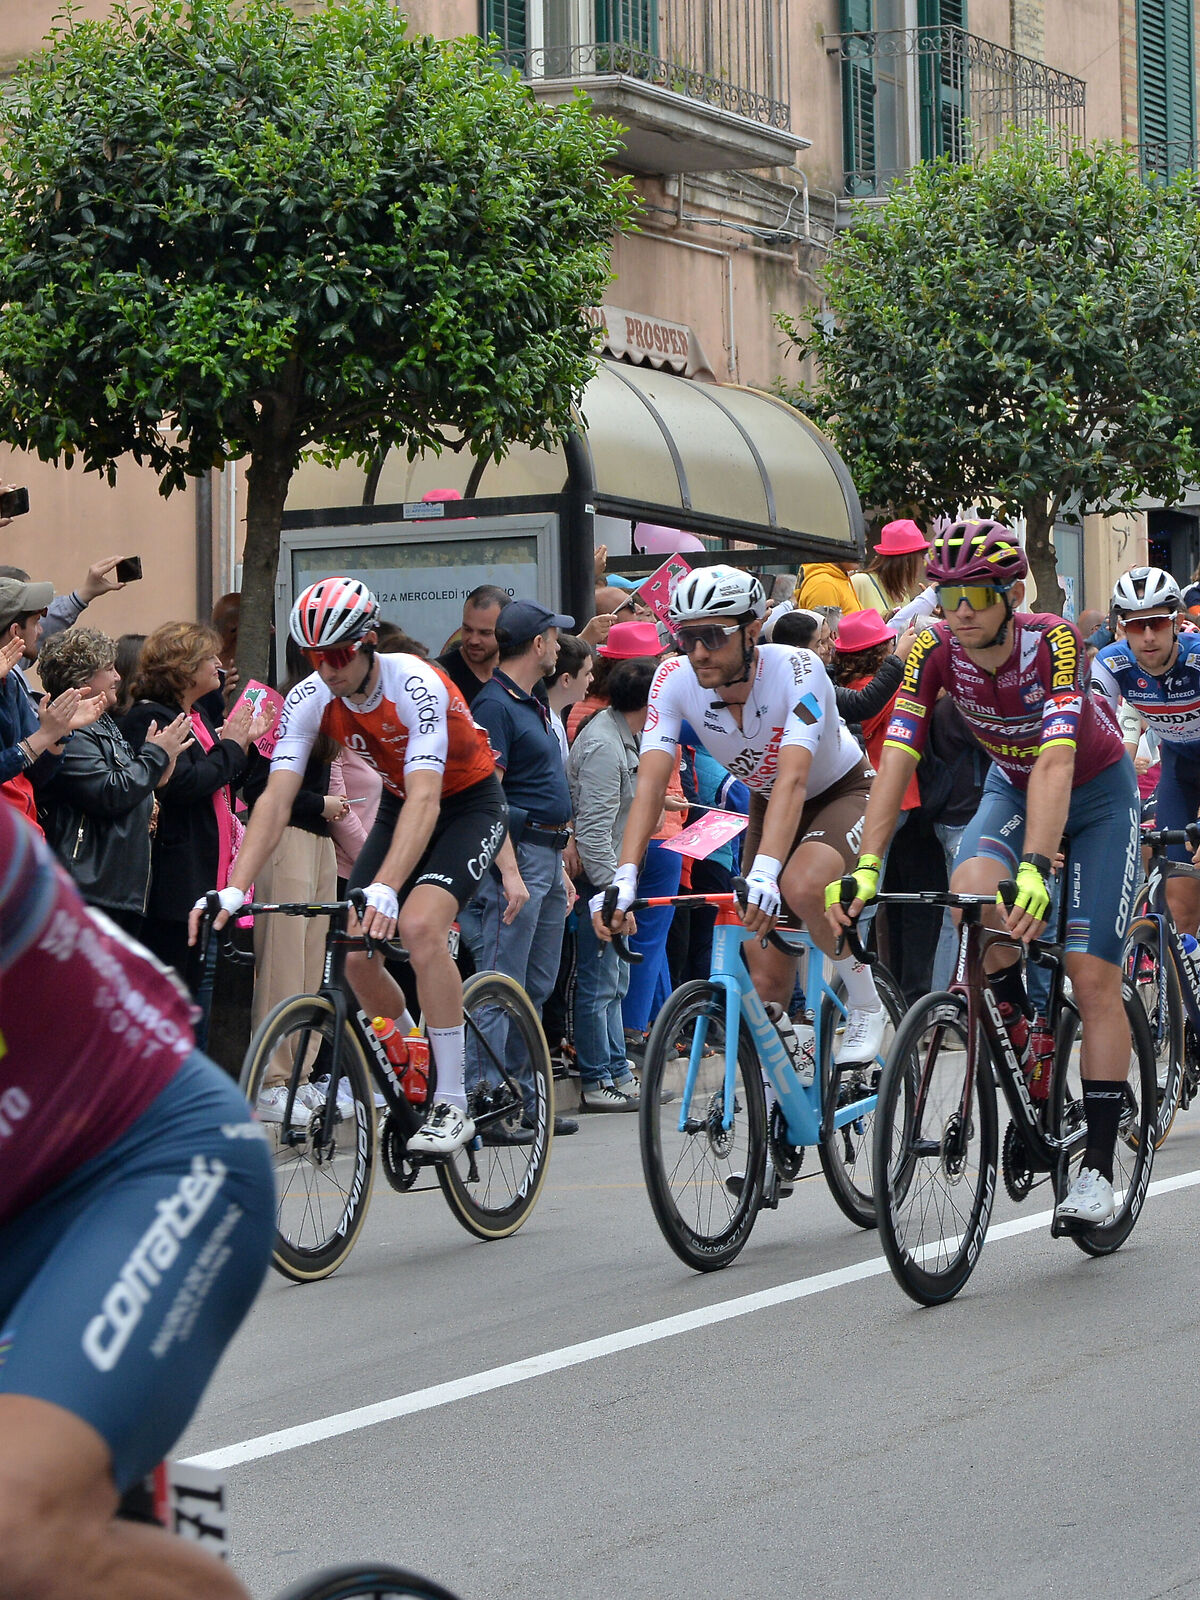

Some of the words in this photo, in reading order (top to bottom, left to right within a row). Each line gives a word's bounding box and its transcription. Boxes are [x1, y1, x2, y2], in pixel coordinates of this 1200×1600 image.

[383, 591, 388, 602] 2
[390, 590, 397, 601] A
[400, 589, 458, 601] MERCOLEDÌ
[404, 675, 439, 735] Cofidis
[1128, 690, 1159, 699] Ekopak
[1167, 689, 1196, 699] latexco
[1042, 722, 1076, 740] NERI
[467, 821, 505, 881] Cofidis
[1114, 807, 1139, 939] corratec
[1072, 862, 1082, 909] URSUS
[356, 1009, 405, 1098] LOOK
[983, 987, 1039, 1127] corratec
[1085, 1090, 1123, 1100] SIDI
[518, 1070, 547, 1199] CORIMA
[337, 1099, 368, 1238] CORIMA
[82, 1154, 228, 1373] corratec
